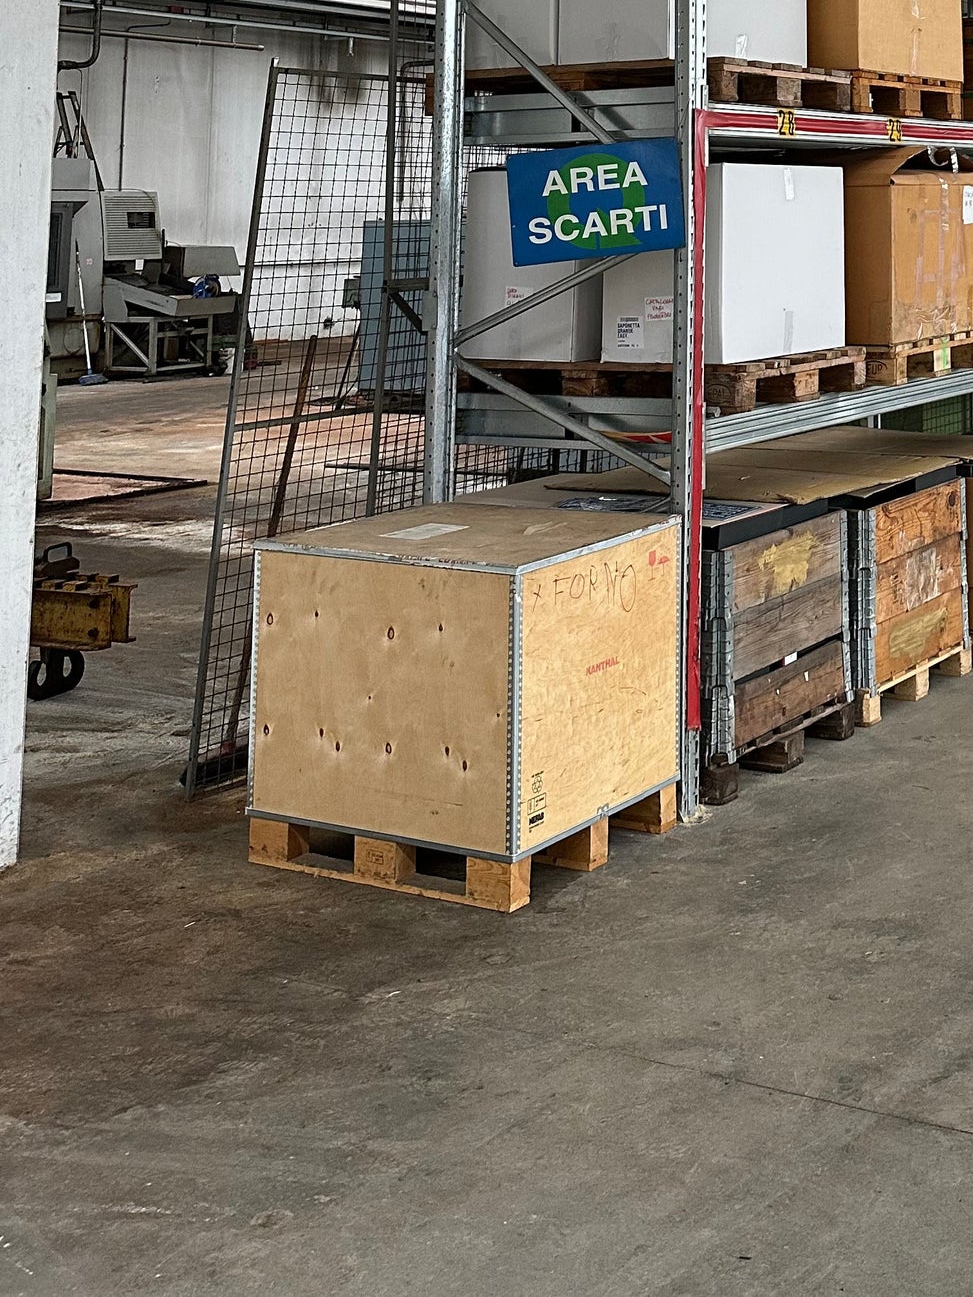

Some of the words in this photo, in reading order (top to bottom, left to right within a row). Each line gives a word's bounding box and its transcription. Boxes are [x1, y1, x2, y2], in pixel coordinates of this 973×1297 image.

[779, 110, 795, 135] 28
[888, 118, 901, 142] 29
[542, 161, 648, 197] AREA
[528, 204, 668, 245] SCARTI
[553, 561, 637, 613] FORNO
[585, 656, 620, 677] KANTHAL
